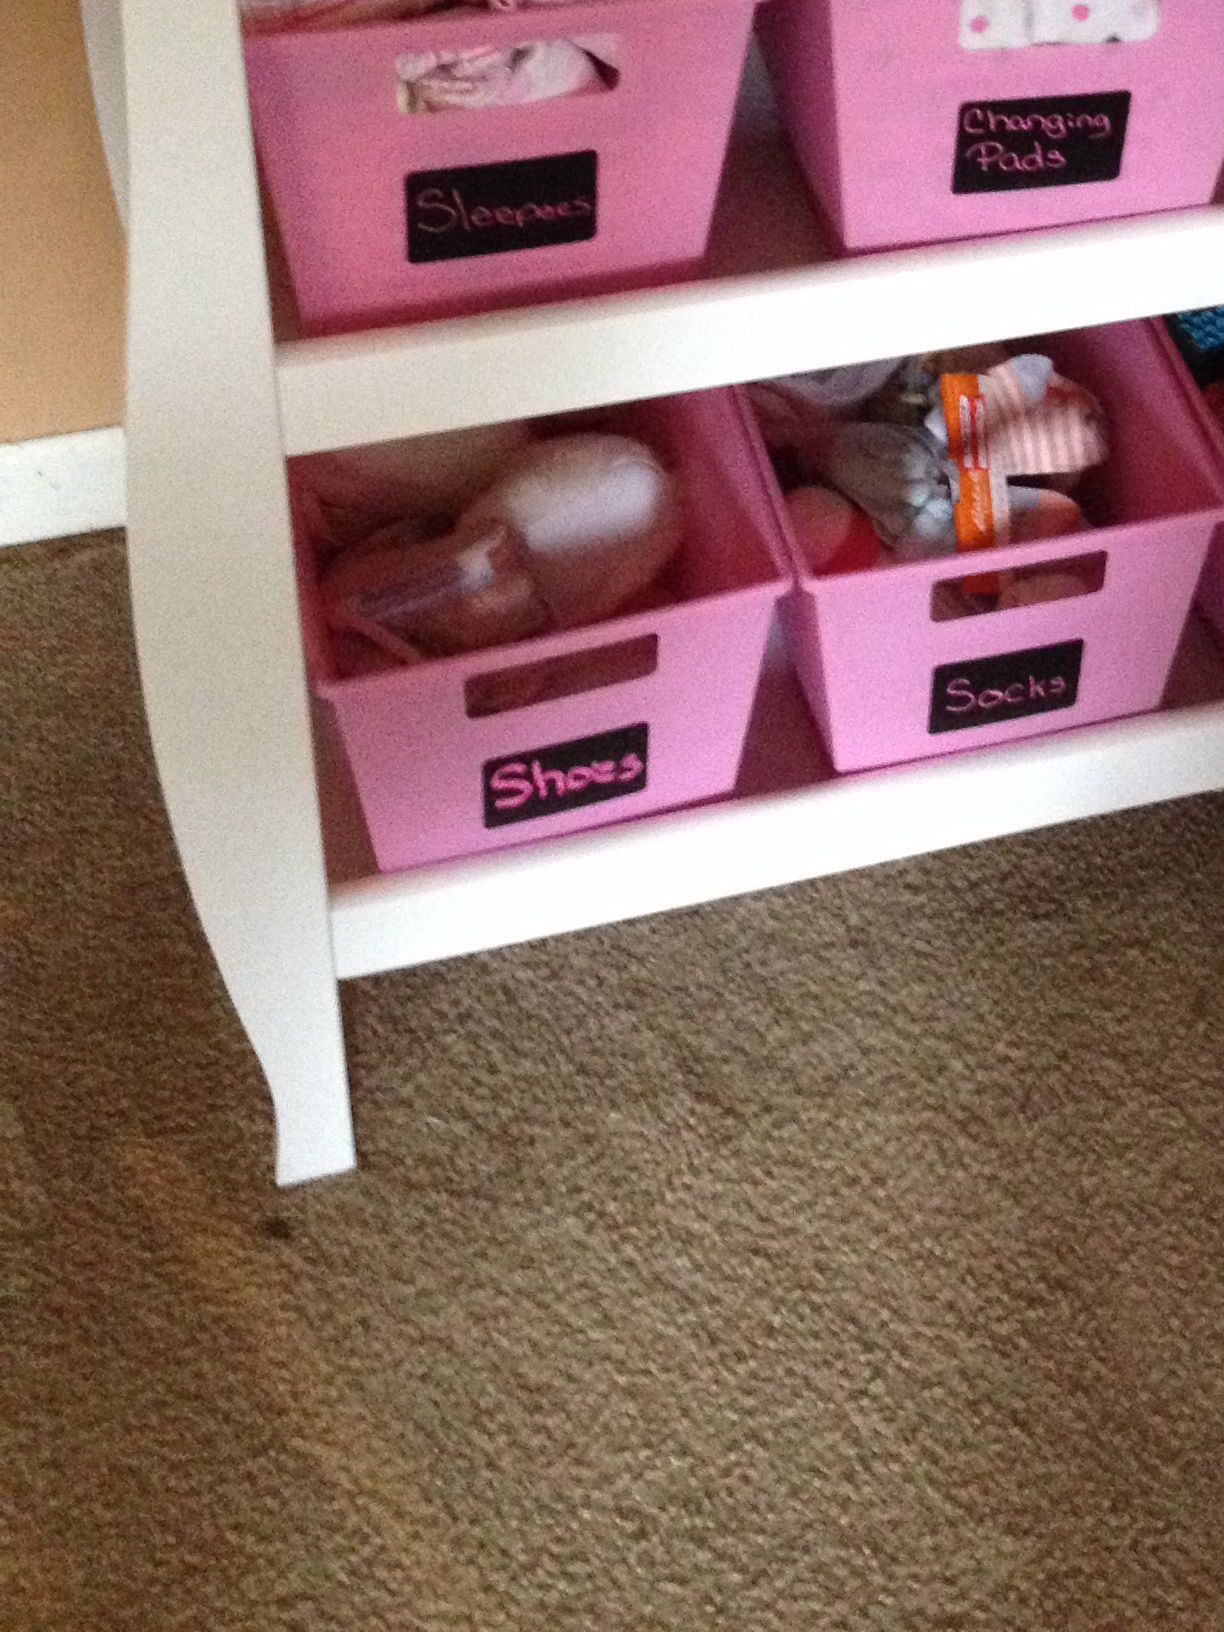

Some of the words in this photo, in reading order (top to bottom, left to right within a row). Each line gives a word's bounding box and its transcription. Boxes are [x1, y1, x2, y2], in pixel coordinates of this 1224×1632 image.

[963, 108, 1112, 140] Changing
[964, 140, 1067, 172] Pads
[945, 675, 1068, 713] Socks
[490, 752, 644, 811] Shoes
